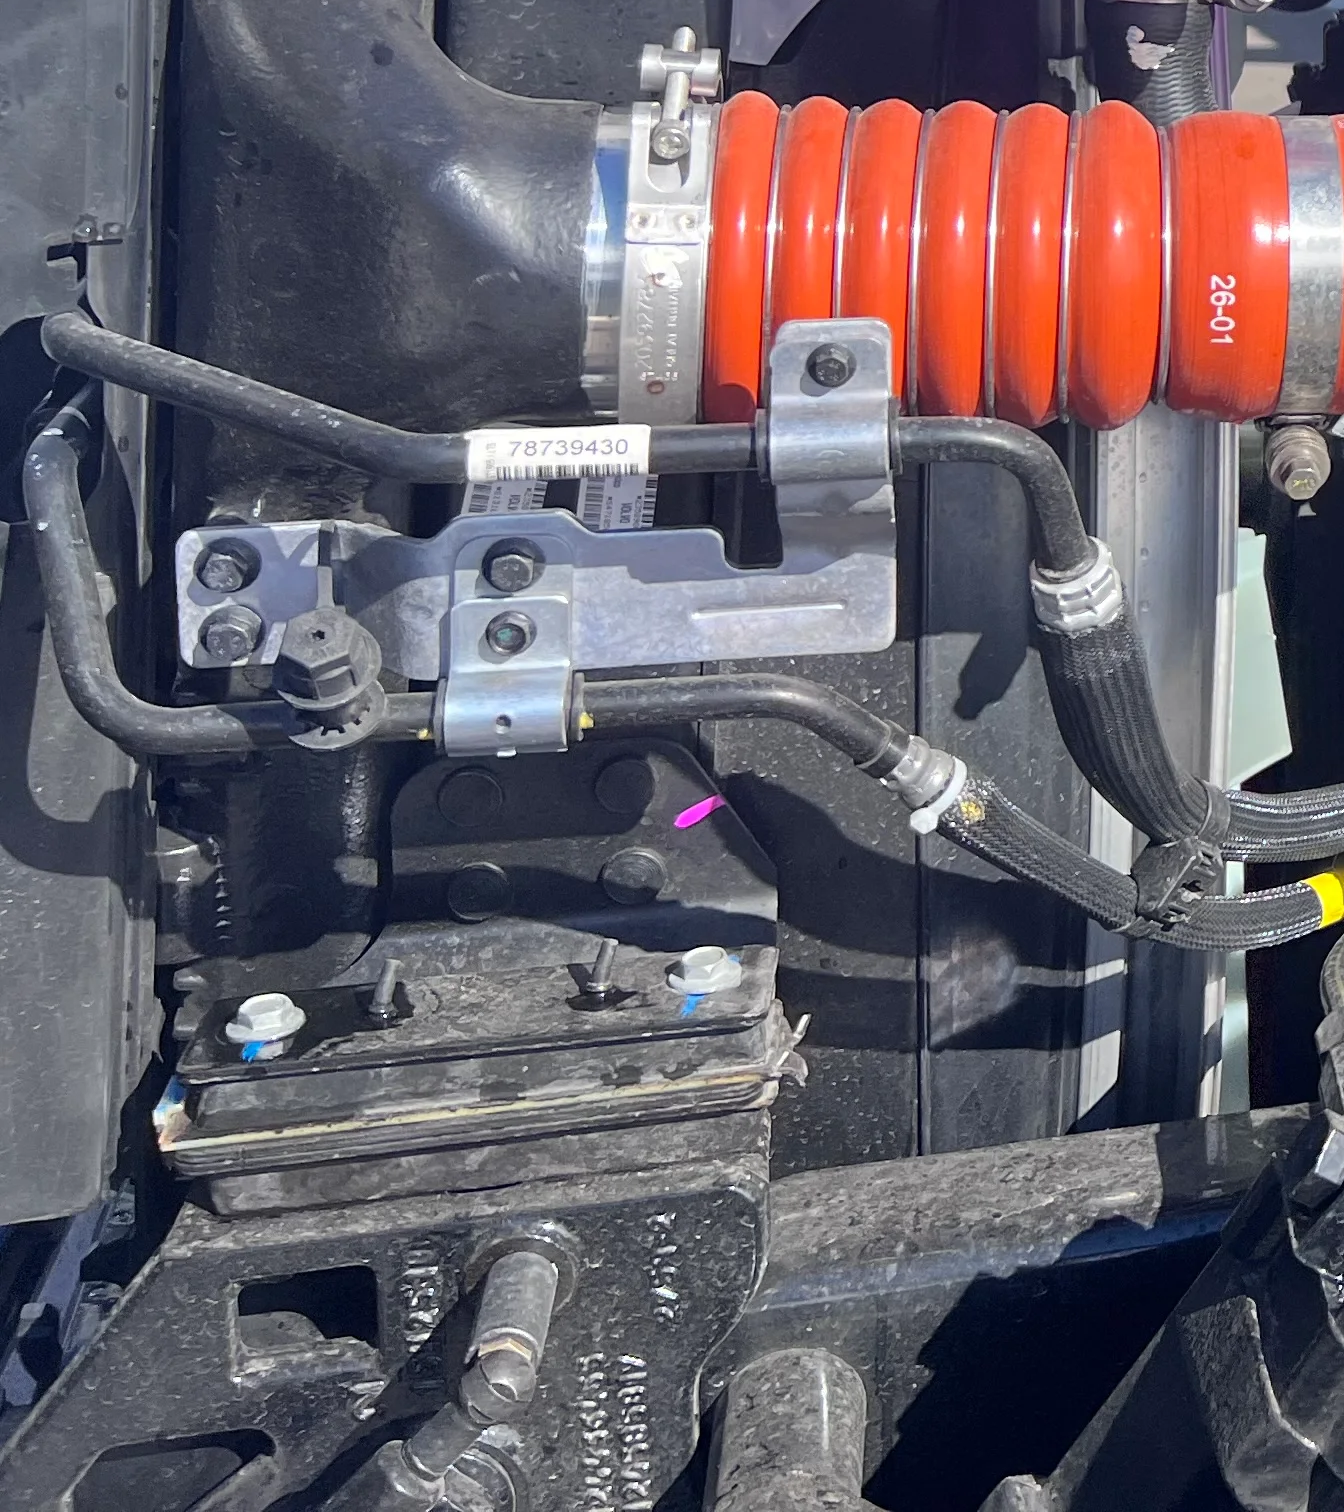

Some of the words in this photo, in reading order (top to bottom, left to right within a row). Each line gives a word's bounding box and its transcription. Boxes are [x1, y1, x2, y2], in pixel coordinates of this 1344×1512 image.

[1209, 274, 1236, 344] 26-01
[509, 439, 628, 457] 78739430
[619, 502, 632, 524] VOLVO
